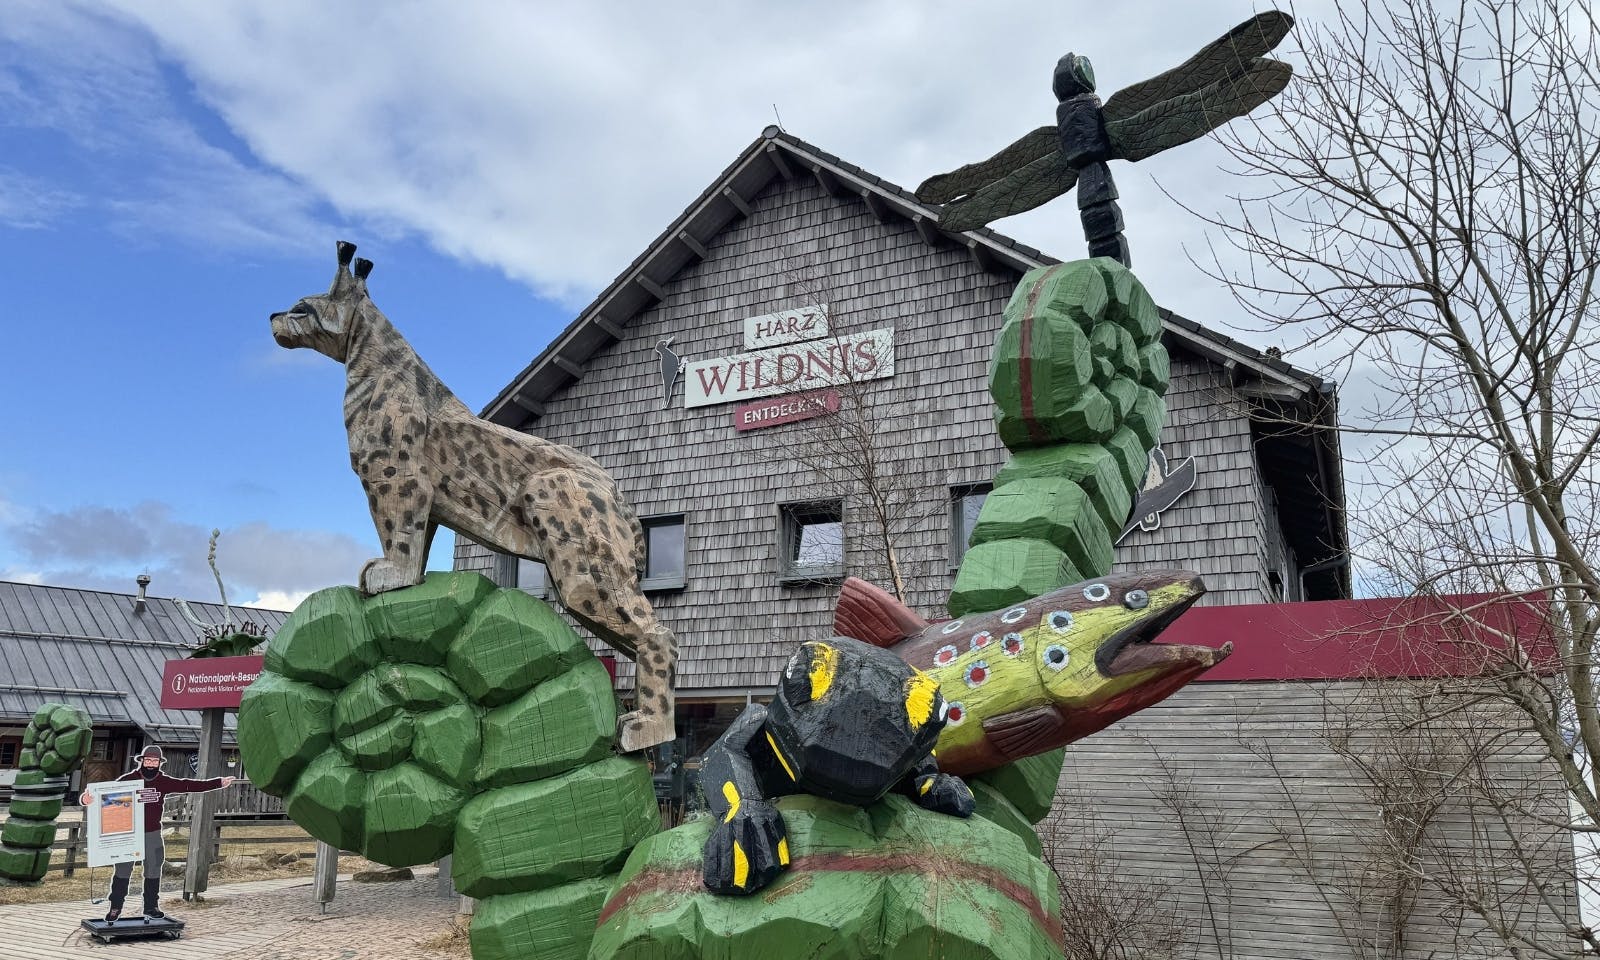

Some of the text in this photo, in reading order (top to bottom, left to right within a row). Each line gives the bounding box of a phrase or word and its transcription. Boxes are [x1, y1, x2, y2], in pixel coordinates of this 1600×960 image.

[755, 313, 816, 338] HARZ
[695, 338, 877, 397] WILDNIS
[189, 672, 260, 684] Nationalpark-Besuc
